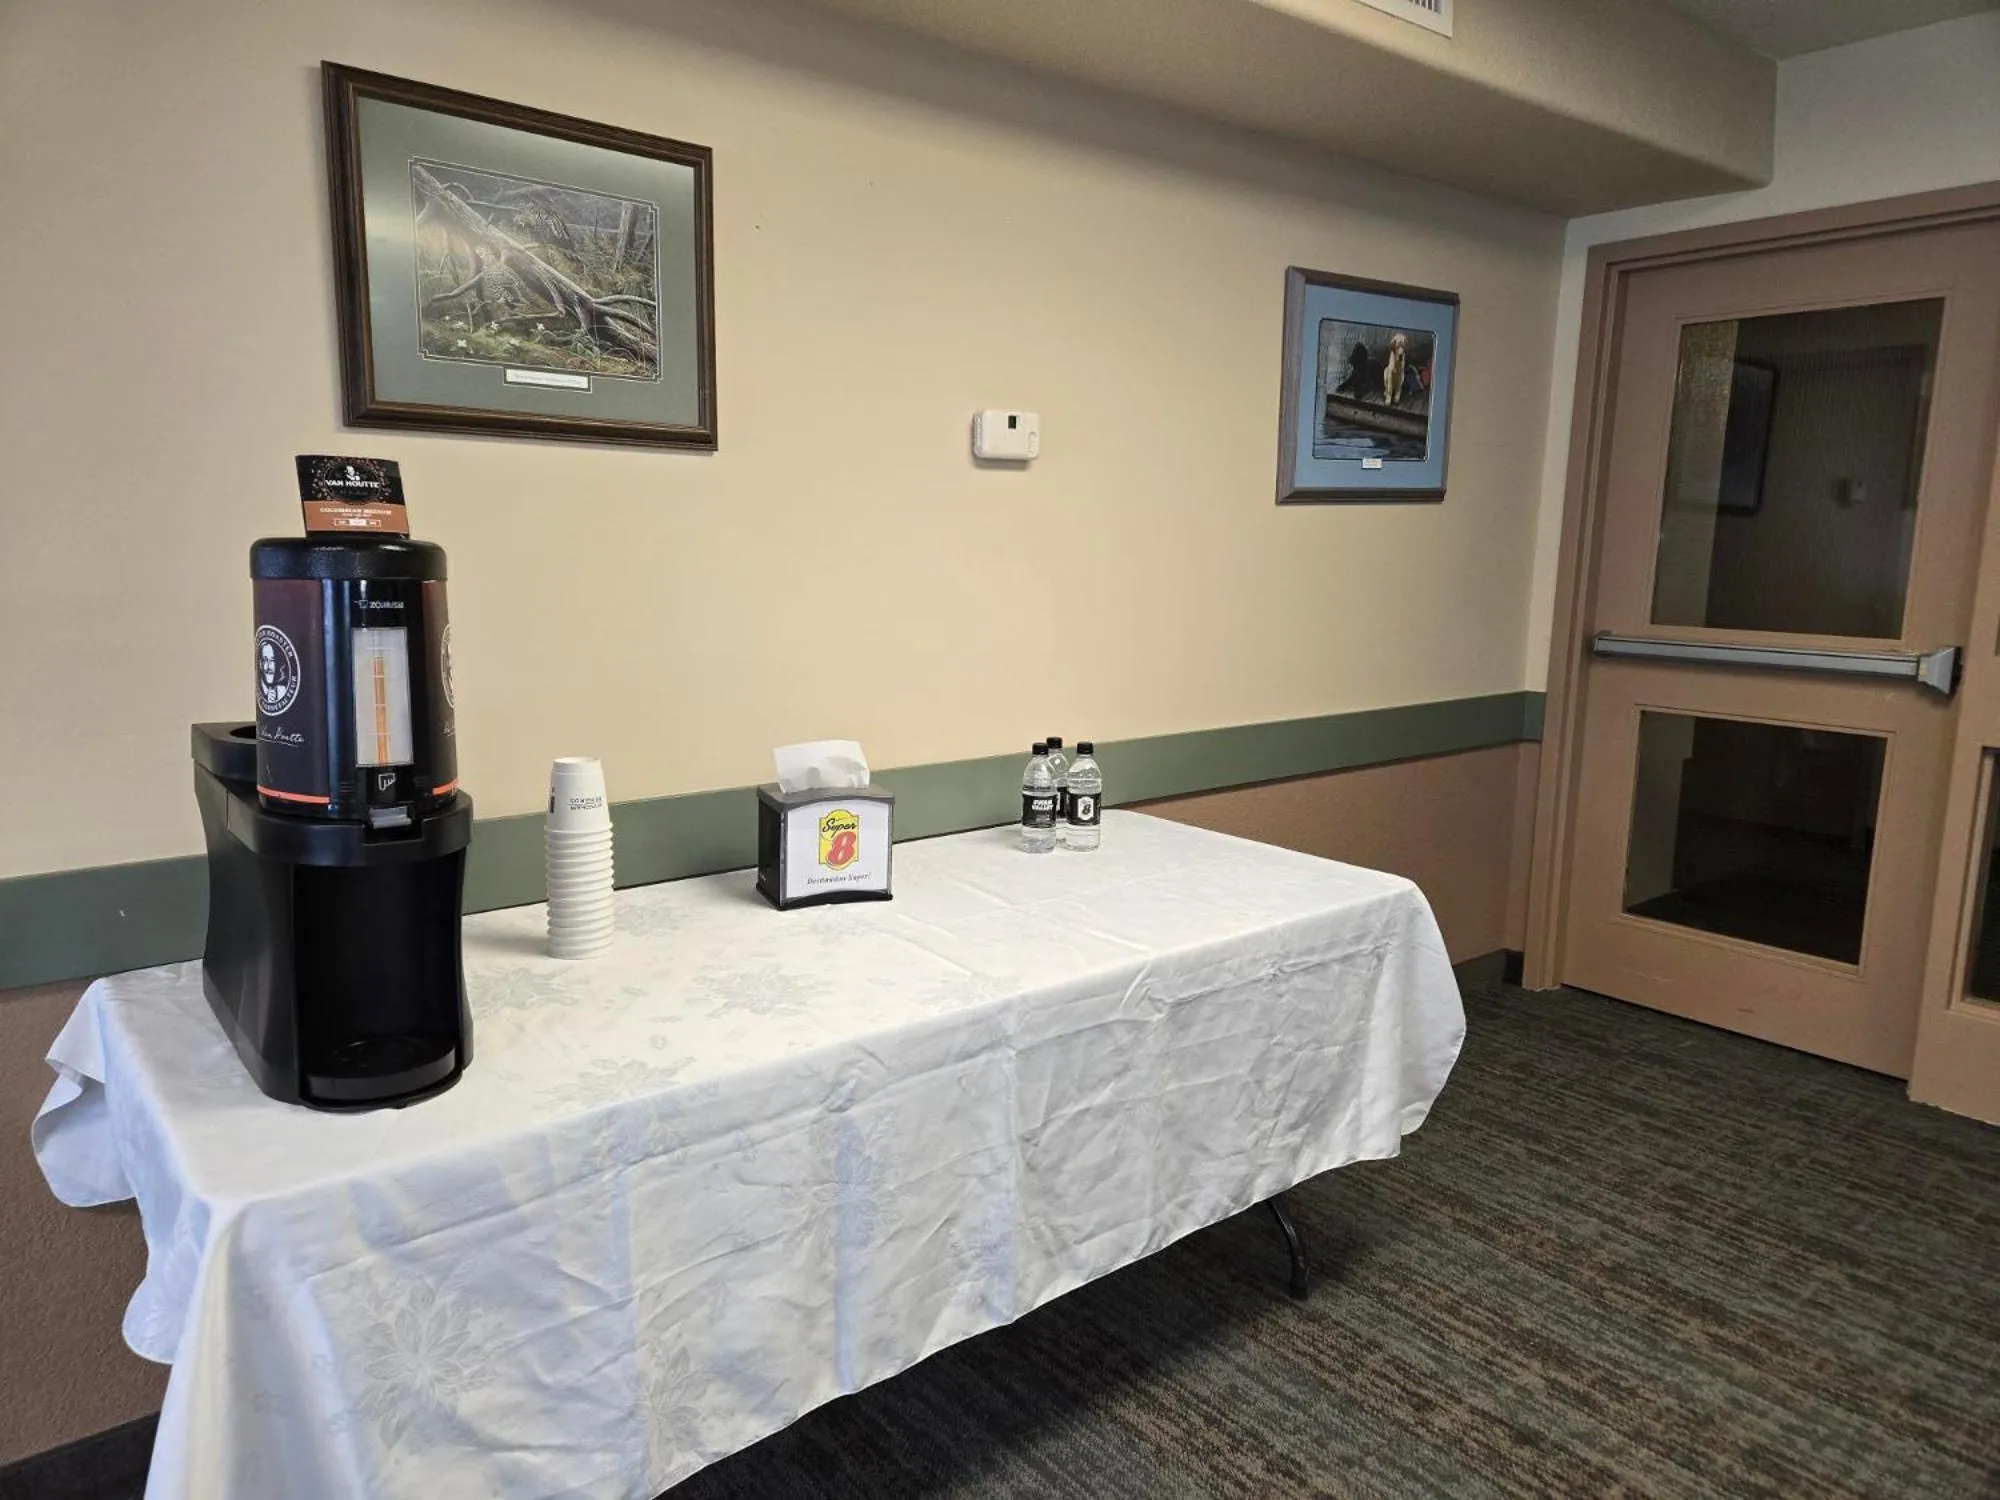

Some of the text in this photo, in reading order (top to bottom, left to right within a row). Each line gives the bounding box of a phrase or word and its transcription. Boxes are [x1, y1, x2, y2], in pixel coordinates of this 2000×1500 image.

[1082, 804, 1091, 815] 8
[822, 818, 857, 838] Super
[827, 831, 857, 866] 8
